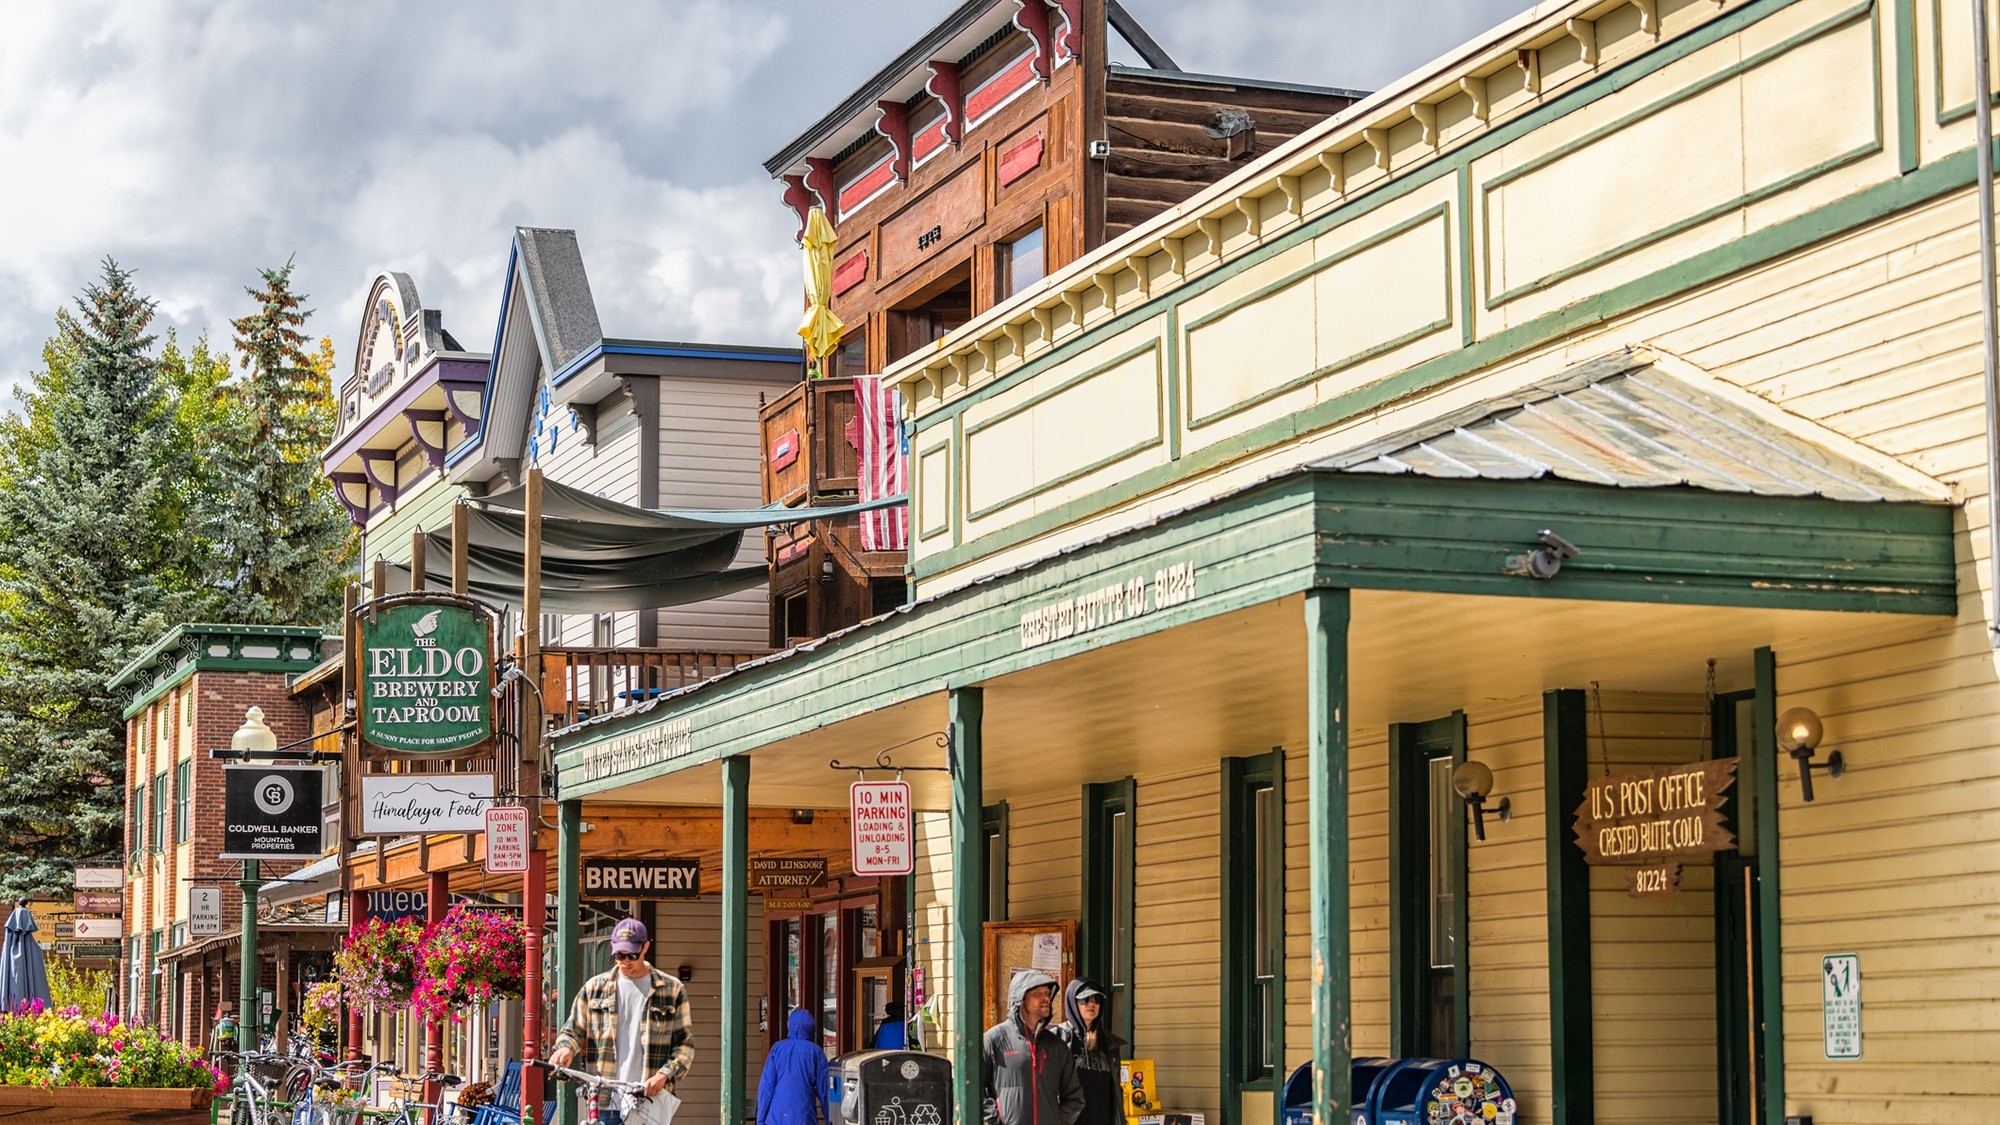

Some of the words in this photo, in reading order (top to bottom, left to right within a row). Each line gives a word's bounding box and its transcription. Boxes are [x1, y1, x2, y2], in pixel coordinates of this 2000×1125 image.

[1076, 582, 1124, 631] BUTTE
[1155, 560, 1195, 610] 81224
[414, 638, 436, 646] THE
[368, 647, 483, 677] ELDO
[373, 680, 480, 698] BREWERY
[415, 698, 438, 706] AND
[372, 706, 480, 723] TAPROOM
[376, 731, 399, 742] SUNNY
[399, 736, 420, 744] PLACE
[436, 734, 458, 744] SHADY
[458, 727, 484, 741] PEOPLE
[860, 792, 872, 804] 10
[880, 792, 902, 804] MIN
[1620, 779, 1654, 817] POST
[1659, 771, 1705, 811] OFFICE
[372, 799, 444, 825] Himalaya
[448, 800, 484, 818] Food
[490, 812, 524, 822] LOADING
[858, 806, 905, 820] PARKING
[228, 824, 279, 833] COLDWELL
[280, 826, 318, 834] BANKER
[496, 824, 517, 832] ZONE
[858, 822, 893, 832] LOADING
[898, 822, 904, 830] &
[859, 834, 905, 842] UNLOADING
[1599, 825, 1639, 856] CRESTED
[1673, 816, 1704, 848] COLO.
[875, 844, 890, 854] 8-5
[493, 852, 522, 860] 8AM-5PM
[866, 856, 900, 865] MON-FRI
[754, 860, 776, 870] DAVID
[780, 860, 824, 870] LEINSDORF
[586, 867, 697, 889] BREWERY
[758, 875, 812, 885] ATTORNEY
[1636, 869, 1668, 892] 81224
[202, 892, 208, 902] 2
